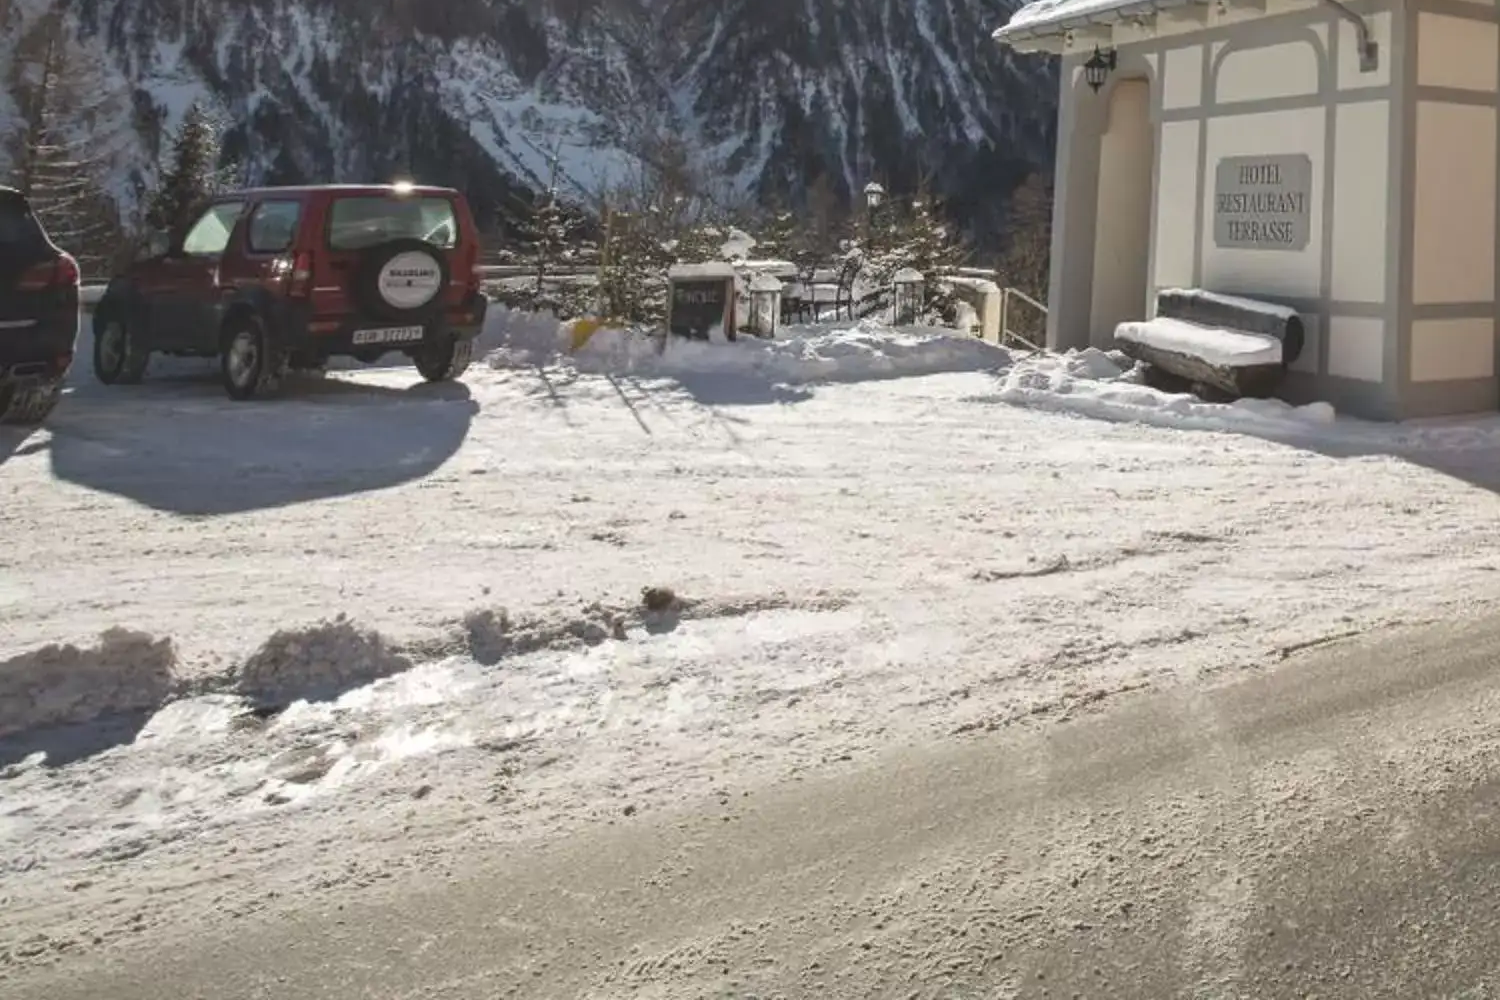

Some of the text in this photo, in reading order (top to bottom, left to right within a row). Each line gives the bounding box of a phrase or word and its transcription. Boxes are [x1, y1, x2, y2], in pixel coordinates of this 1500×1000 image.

[1239, 163, 1282, 185] HOTEL
[1217, 192, 1304, 213] RESTAURANT
[1228, 221, 1293, 242] TERRASSE
